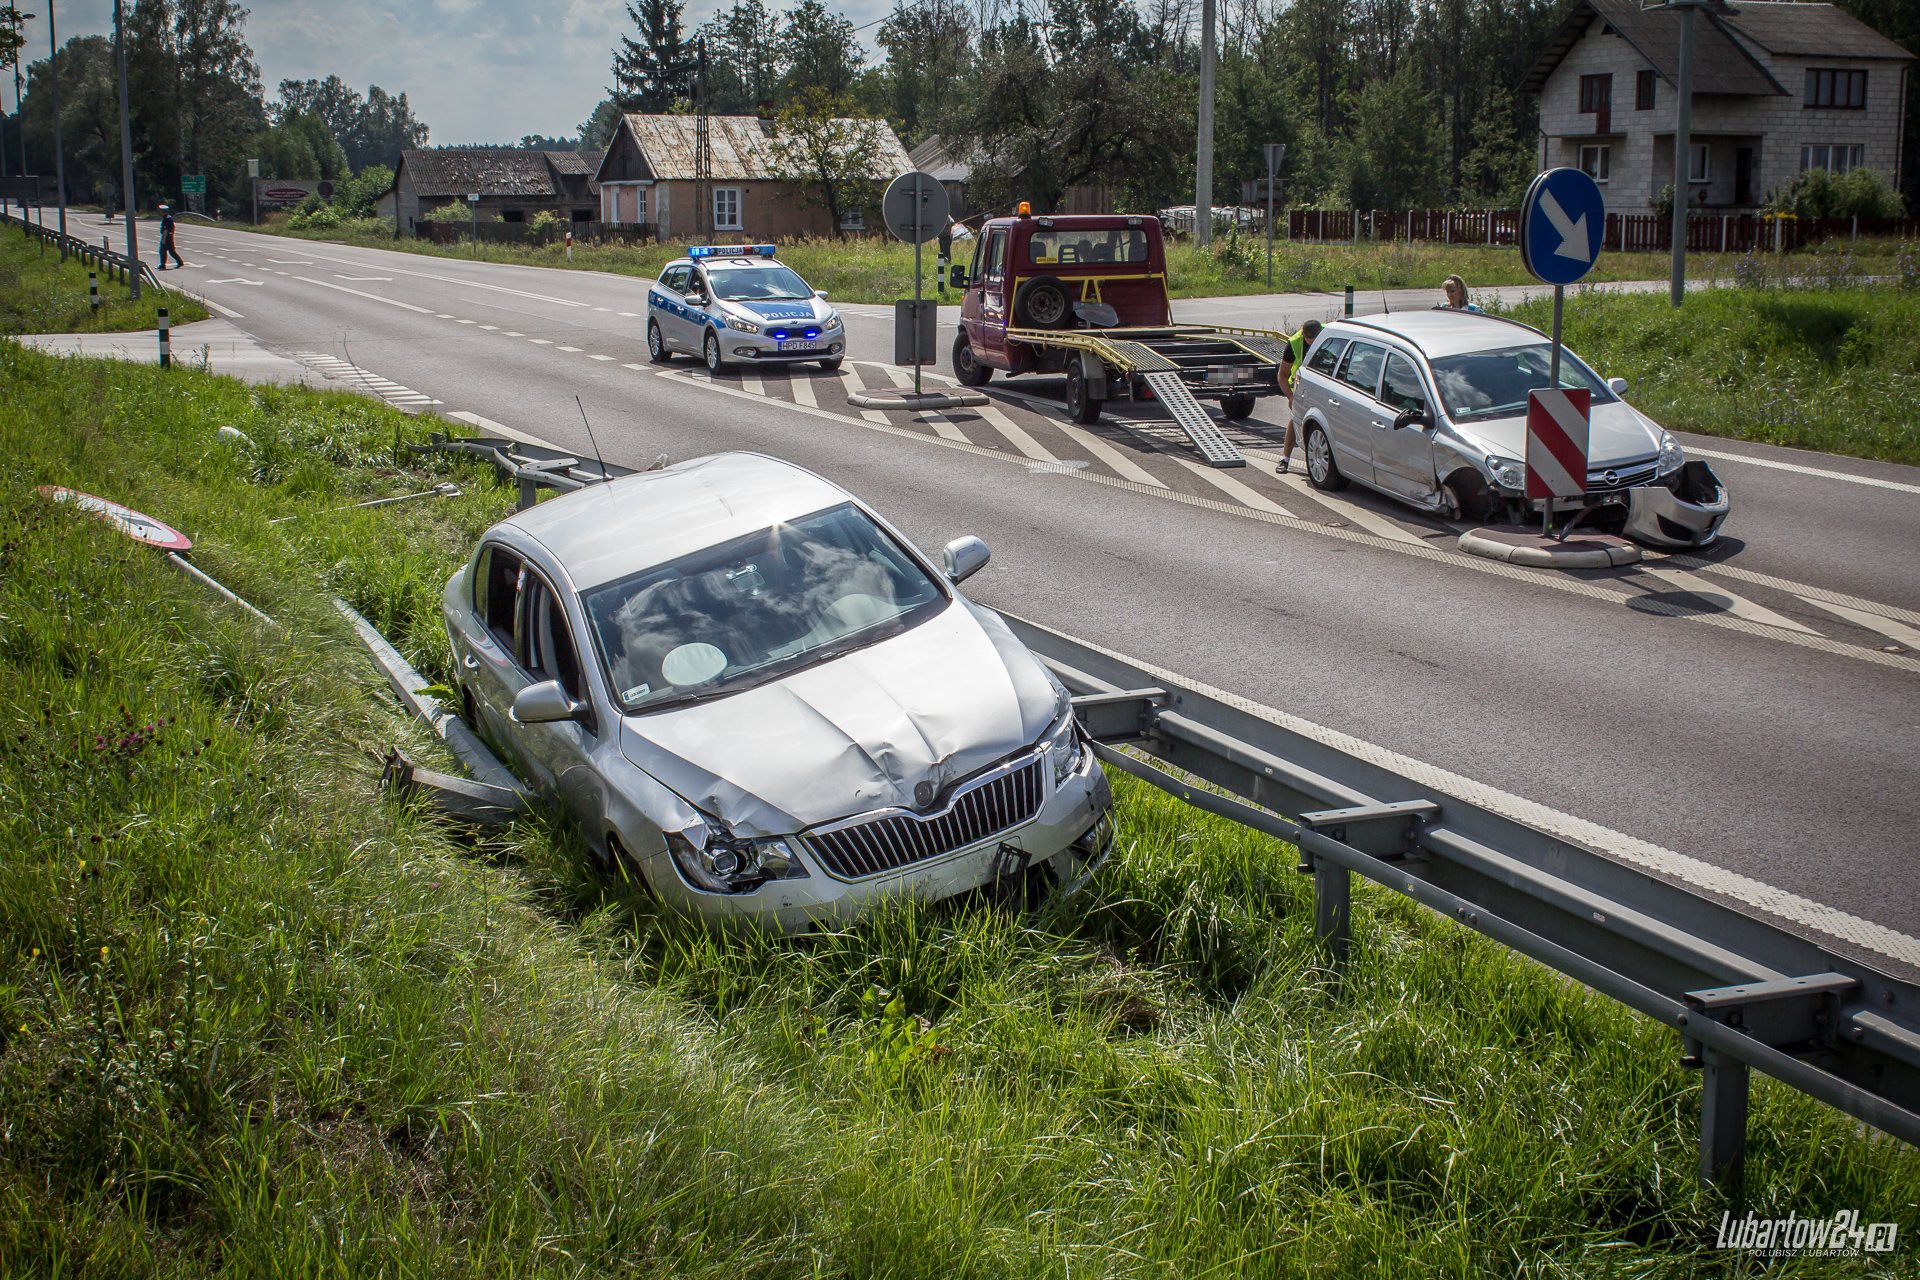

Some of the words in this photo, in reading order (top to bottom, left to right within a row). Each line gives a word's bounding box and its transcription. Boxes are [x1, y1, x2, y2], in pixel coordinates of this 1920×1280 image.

[718, 247, 743, 255] POLICJA
[761, 311, 815, 320] POLICJA
[782, 341, 798, 350] HPD
[799, 341, 815, 350] F845
